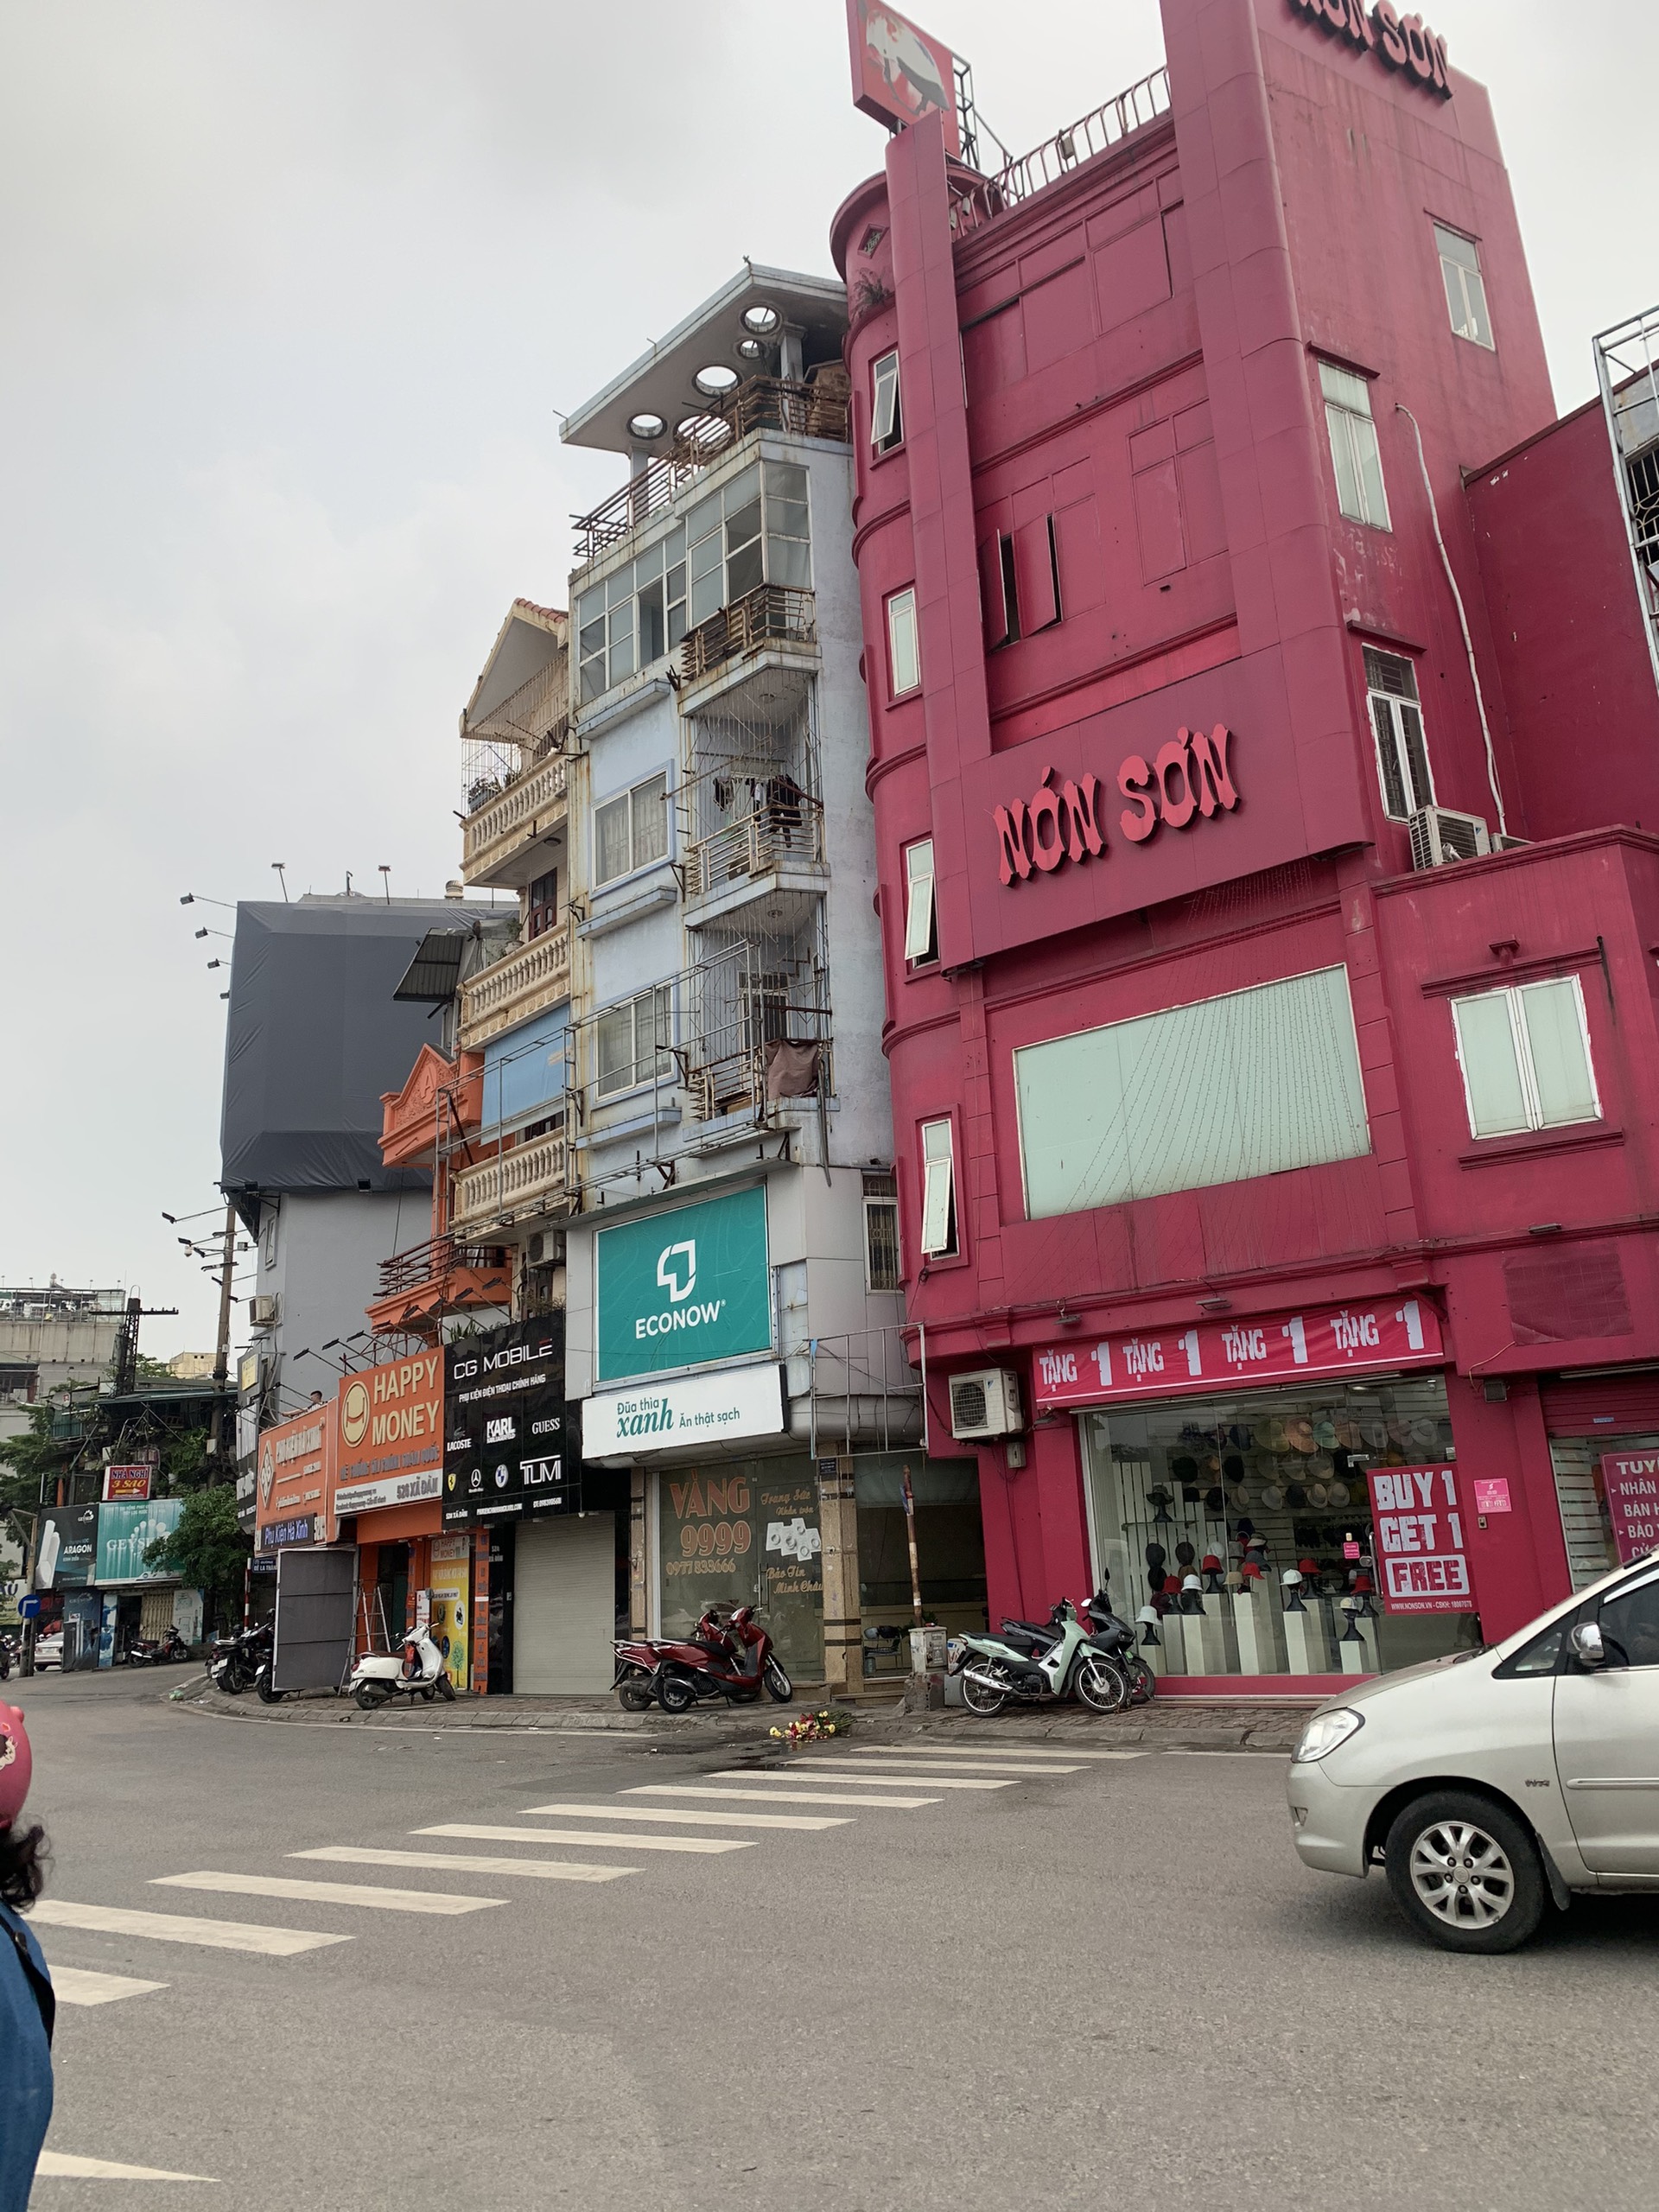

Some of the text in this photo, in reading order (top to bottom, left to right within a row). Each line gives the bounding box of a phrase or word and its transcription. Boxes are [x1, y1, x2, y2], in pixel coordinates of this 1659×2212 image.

[1374, 0, 1452, 98] SƠN
[994, 723, 1240, 887] NÓN SƠN
[635, 1300, 721, 1339] ECONOW
[454, 1338, 553, 1380] CG MOBILE
[1039, 1300, 1425, 1392] TẶNG 1 TẶNG 1 TẶNG 1 TẶNG 1
[373, 1356, 439, 1406] HAPPY
[372, 1399, 441, 1447] MONEY
[486, 1416, 516, 1438] KARL
[531, 1417, 561, 1434] GUESS
[617, 1402, 637, 1415] Đũa
[617, 1397, 674, 1438] xanh
[695, 1411, 715, 1427] thật
[716, 1407, 741, 1425] sạch
[447, 1438, 472, 1452] LACOSTE
[519, 1454, 562, 1485] TUMI
[1619, 1478, 1656, 1496] NHÂN
[670, 1470, 750, 1519] VÀNG
[1373, 1471, 1433, 1511] BUY
[1441, 1470, 1458, 1506] 1
[1624, 1500, 1650, 1517] BÁN
[680, 1520, 751, 1557] 9999
[1379, 1512, 1464, 1553] GET 1
[1627, 1521, 1655, 1538] BẢO
[63, 1543, 92, 1555] ARAGON
[1392, 1560, 1463, 1592] FREE
